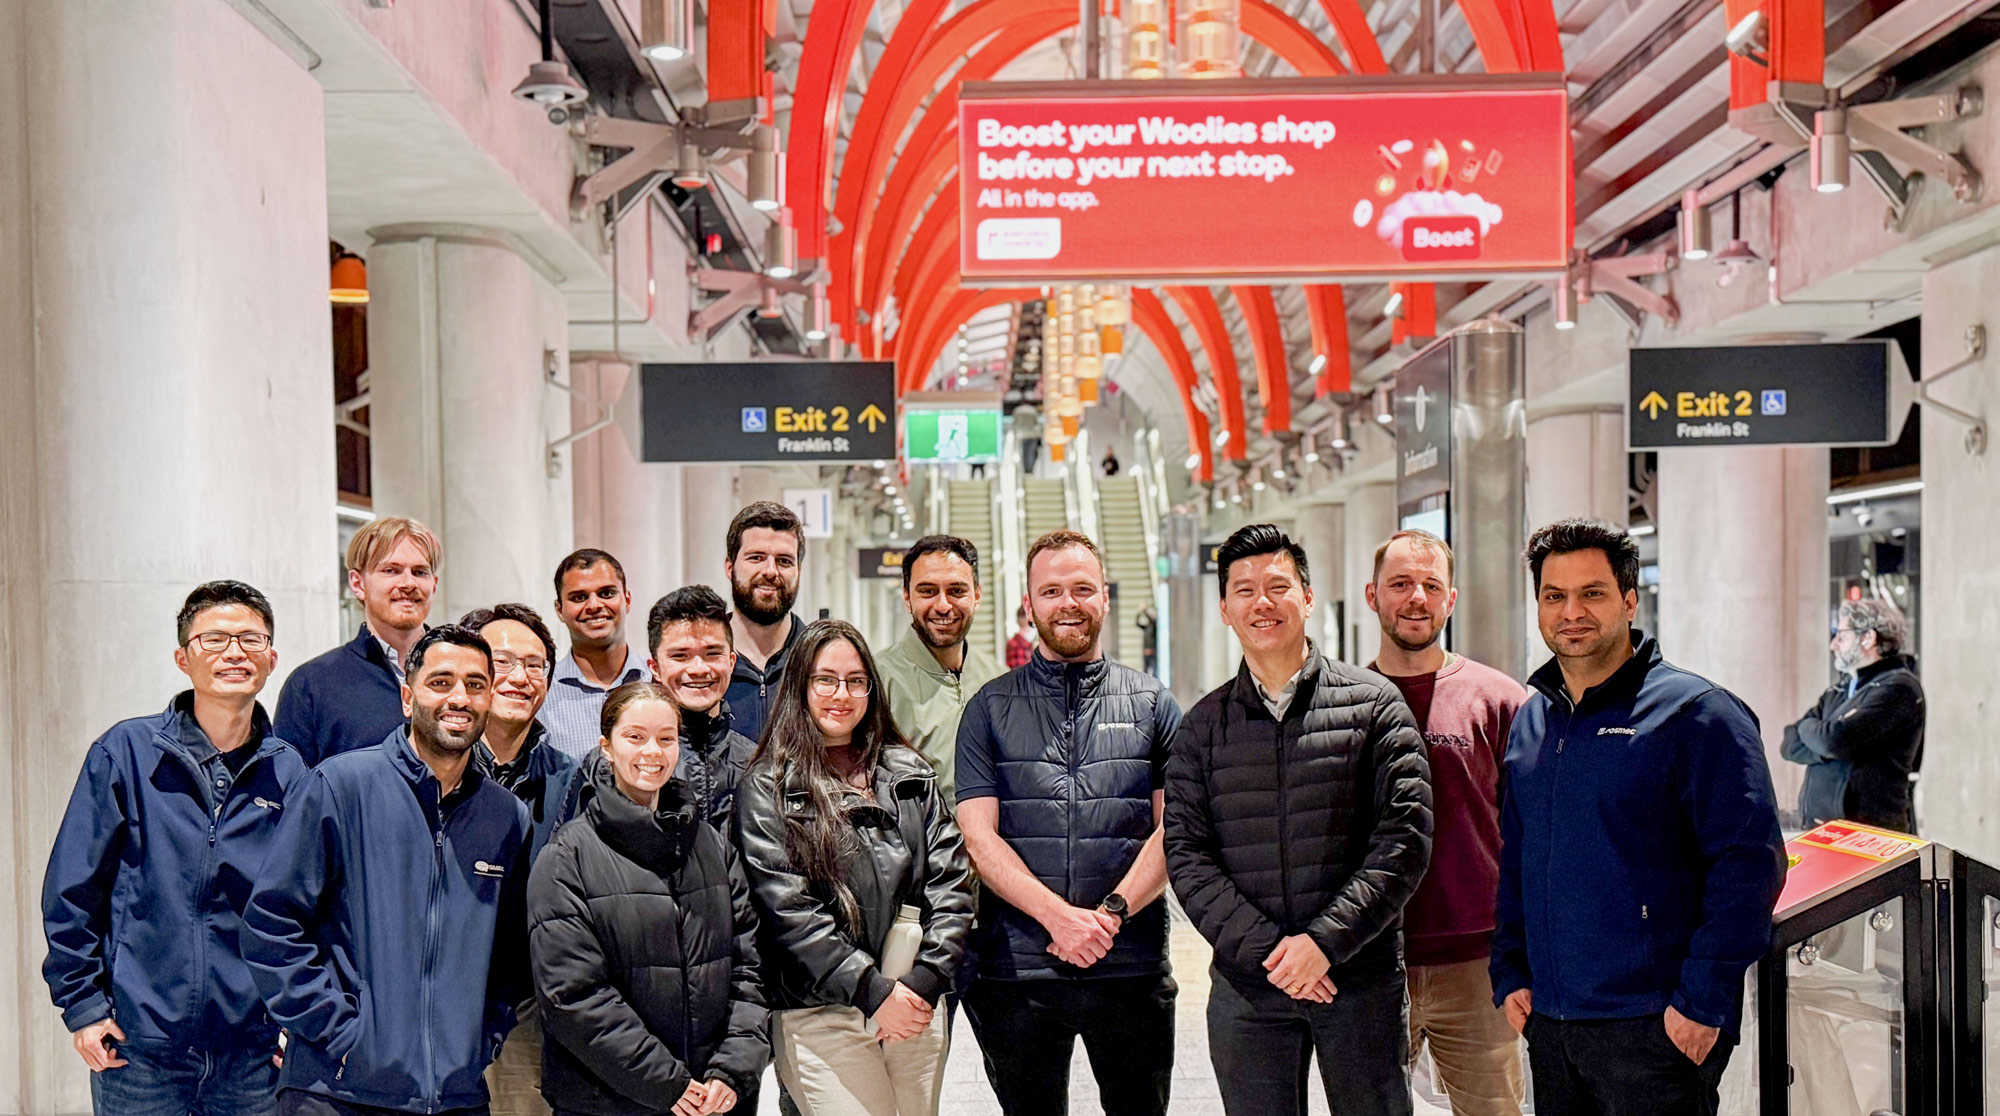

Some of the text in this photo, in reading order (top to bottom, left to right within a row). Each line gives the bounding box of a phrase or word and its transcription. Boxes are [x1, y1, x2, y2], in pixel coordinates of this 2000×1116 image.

[977, 114, 1336, 153] Boost your Woolies shop
[978, 150, 1295, 186] before your next stop.
[977, 188, 1100, 211] All in the app.
[1413, 227, 1475, 248] Boost
[1677, 389, 1752, 417] Exit 2
[775, 405, 849, 432] Exit 2
[1676, 421, 1750, 438] Franklin St
[778, 436, 850, 452] Franklin St
